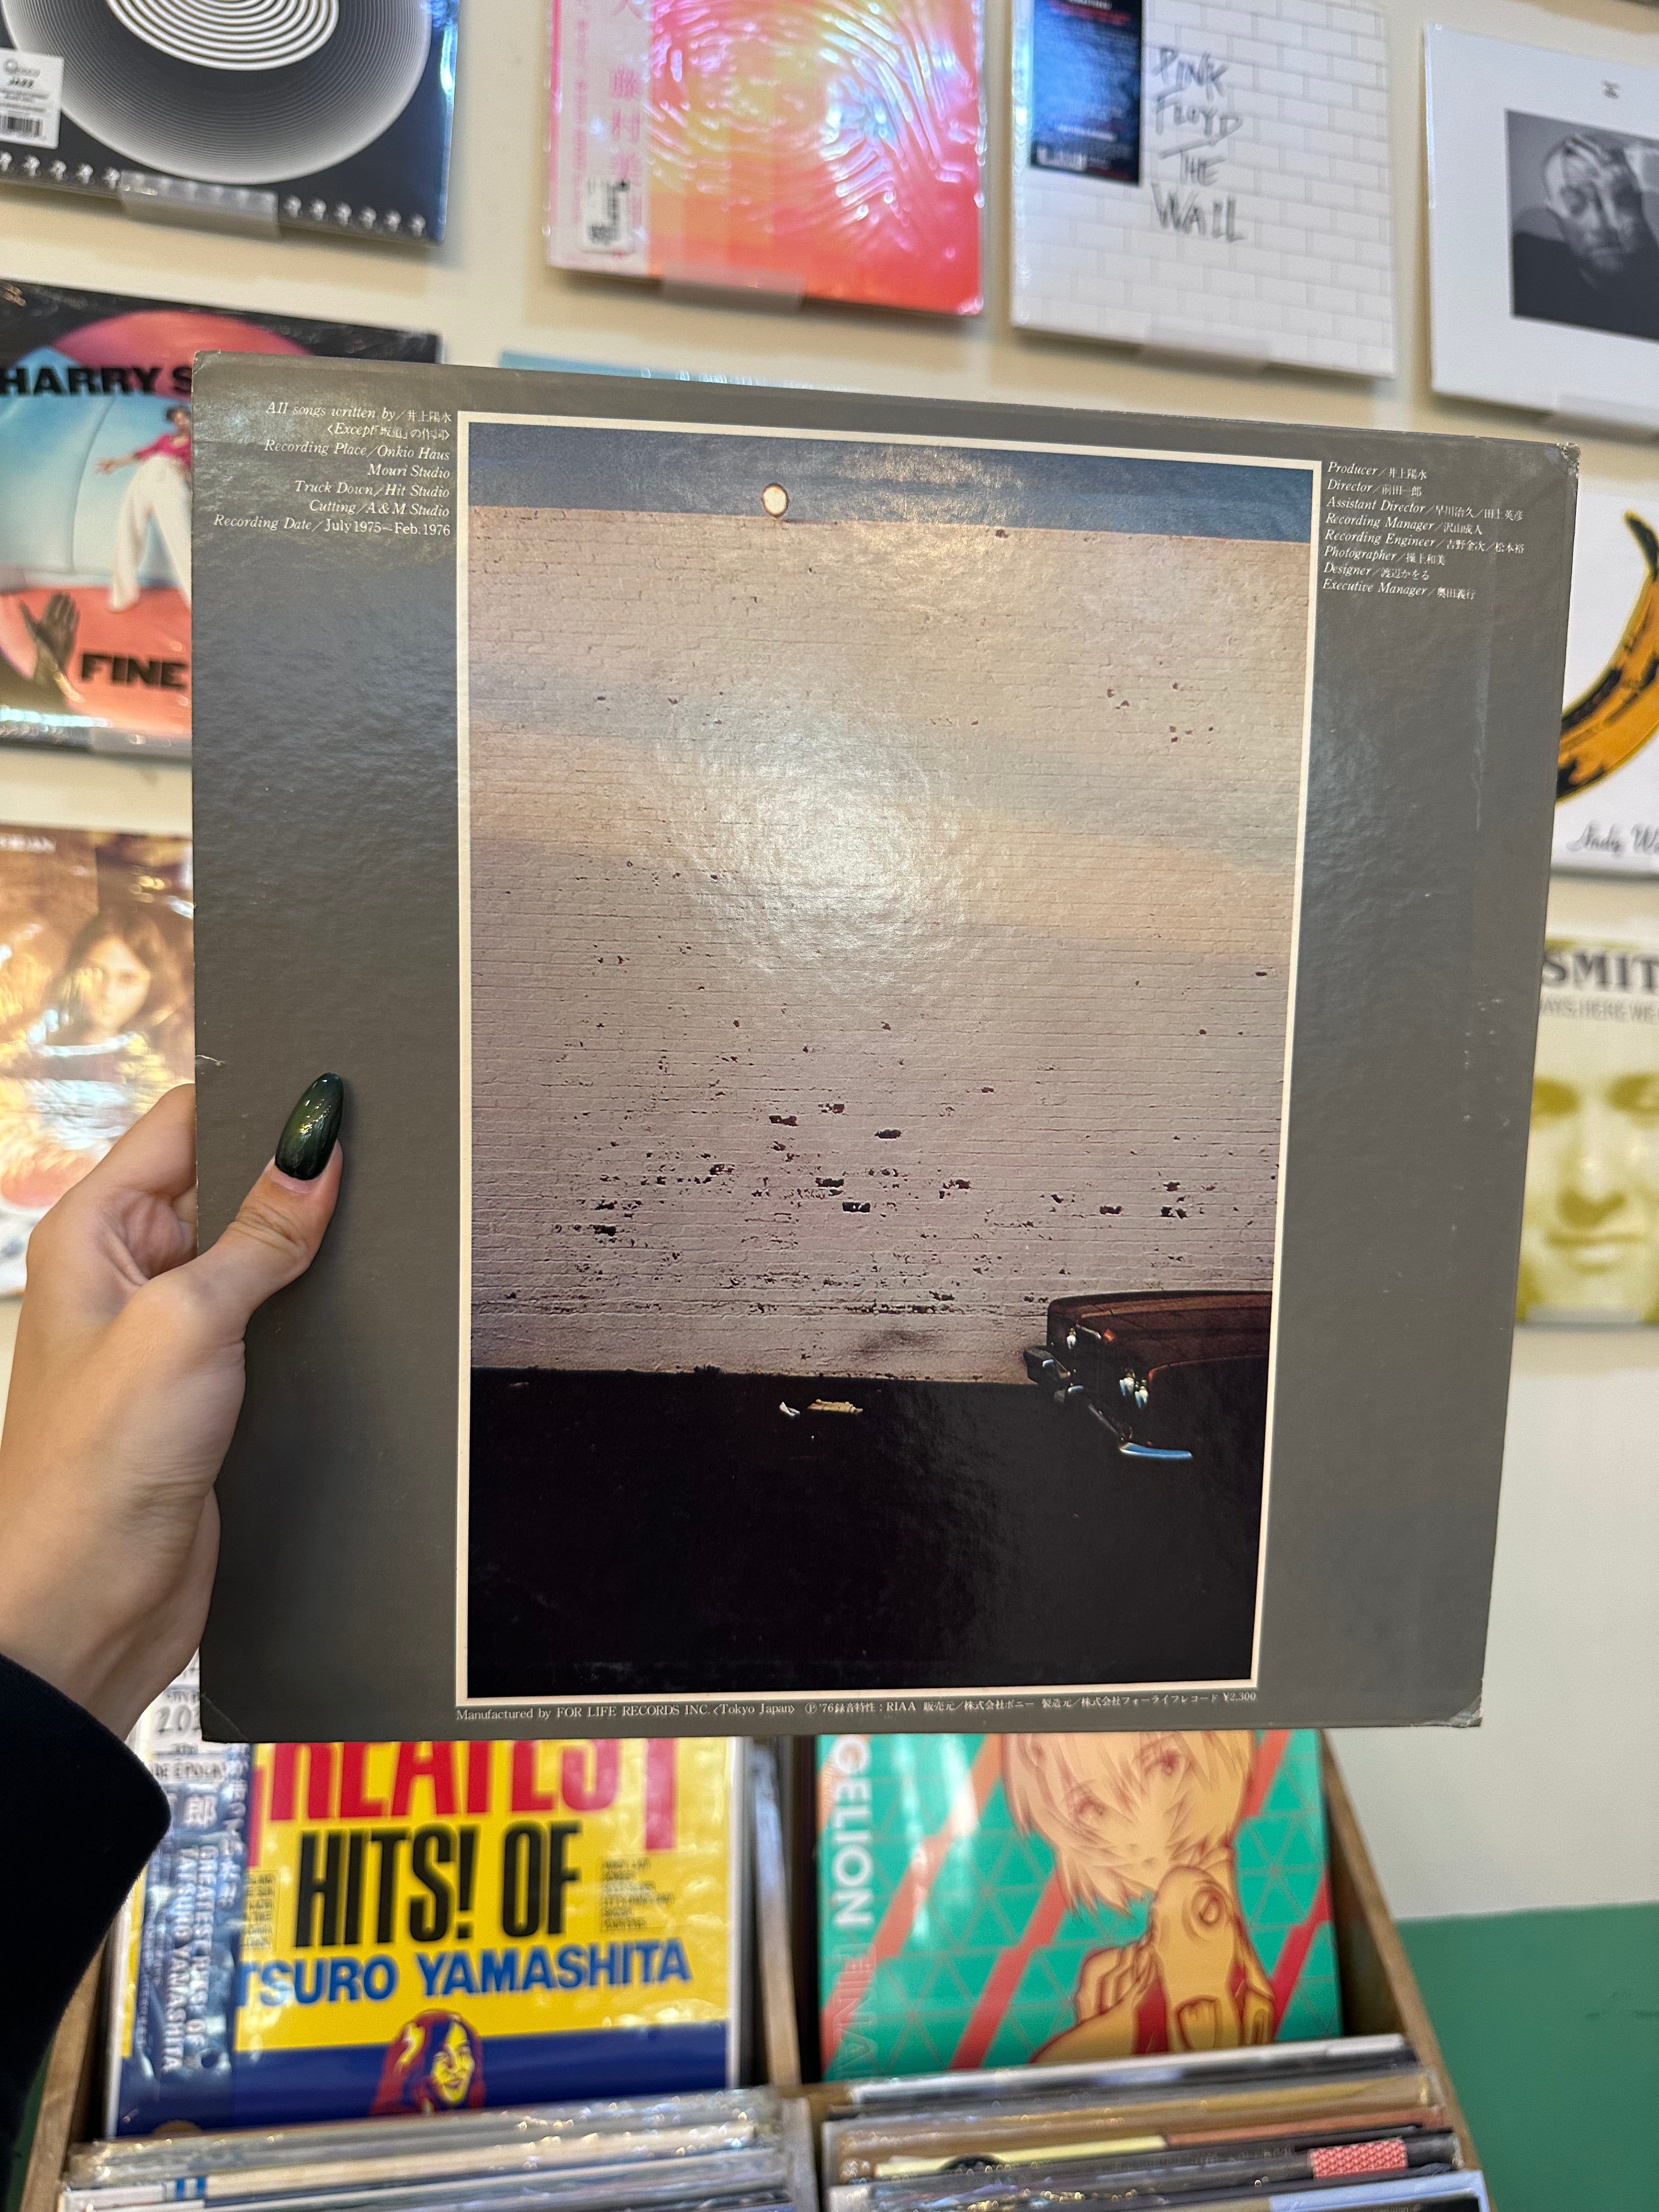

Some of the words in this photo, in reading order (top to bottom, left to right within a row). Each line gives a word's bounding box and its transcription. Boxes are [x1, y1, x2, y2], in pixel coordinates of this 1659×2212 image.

[1152, 182, 1245, 243] WALL
[0, 366, 162, 396] HARRY
[293, 406, 326, 417] songs
[331, 406, 376, 419] written
[264, 439, 329, 456] Recording
[418, 447, 450, 461] Haus
[367, 464, 408, 476] Mouri
[410, 465, 450, 479] Studio
[295, 480, 332, 493] Truck
[410, 485, 449, 498] Studio
[392, 503, 407, 515] M
[410, 504, 450, 517] Studio
[1326, 496, 1378, 510] Assistant
[214, 514, 279, 531] Recording
[1325, 512, 1381, 529] Recording
[1324, 529, 1381, 546] Recording
[1322, 578, 1374, 592] Executive
[81, 654, 187, 689] FINE
[456, 1708, 533, 1720] Manufactured
[538, 1707, 551, 1720] by
[556, 1707, 582, 1718] FOR
[587, 1706, 617, 1717] LIFE
[622, 1705, 680, 1717] RECORDS
[685, 1704, 710, 1716] INC.
[295, 1826, 479, 1948] HITS!
[503, 1821, 582, 1938] OF
[418, 1938, 692, 1997] YAMASHITA
